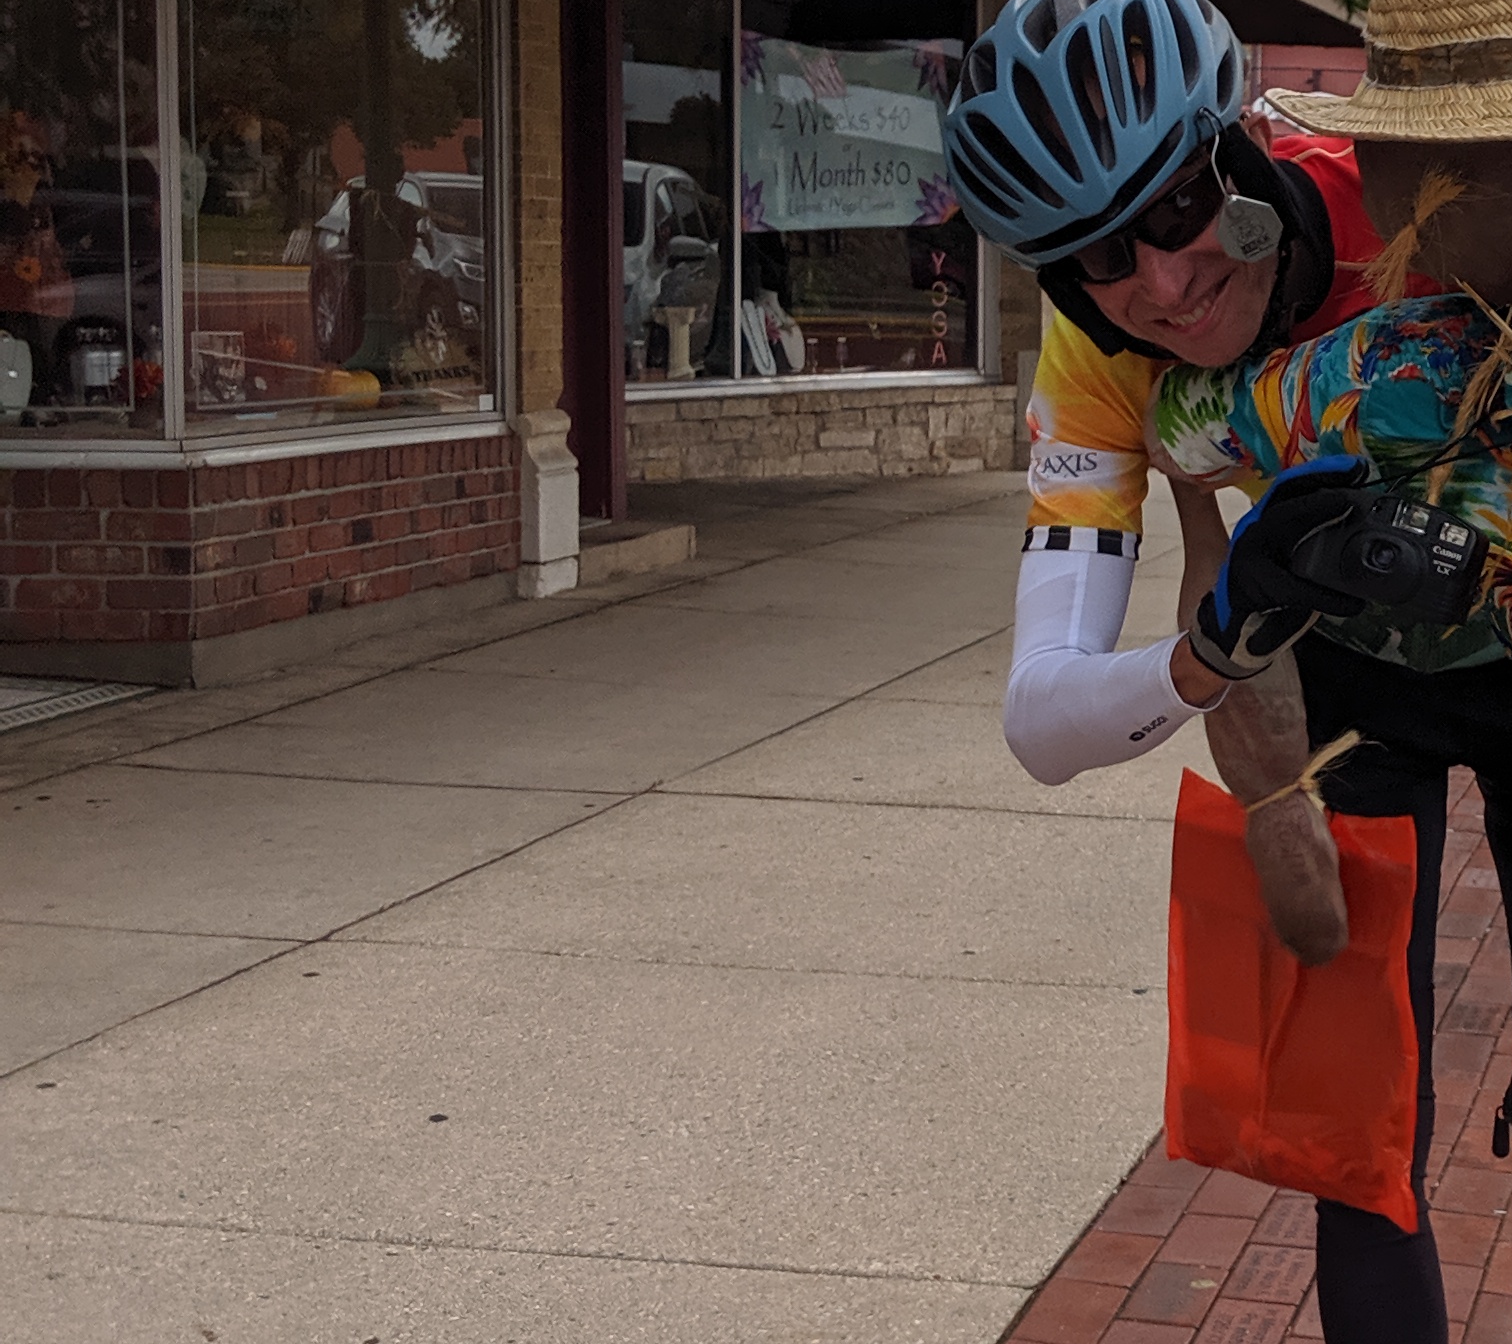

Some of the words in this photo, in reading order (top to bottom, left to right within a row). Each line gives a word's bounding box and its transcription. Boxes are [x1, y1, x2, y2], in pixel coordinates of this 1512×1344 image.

[769, 101, 786, 131] 2
[796, 97, 870, 137] Weeks
[875, 105, 911, 133] $40
[790, 150, 866, 194] Month
[871, 160, 912, 187] $80
[931, 251, 948, 366] YOGA
[1038, 452, 1098, 478] AXIS
[1432, 545, 1463, 563] Canon
